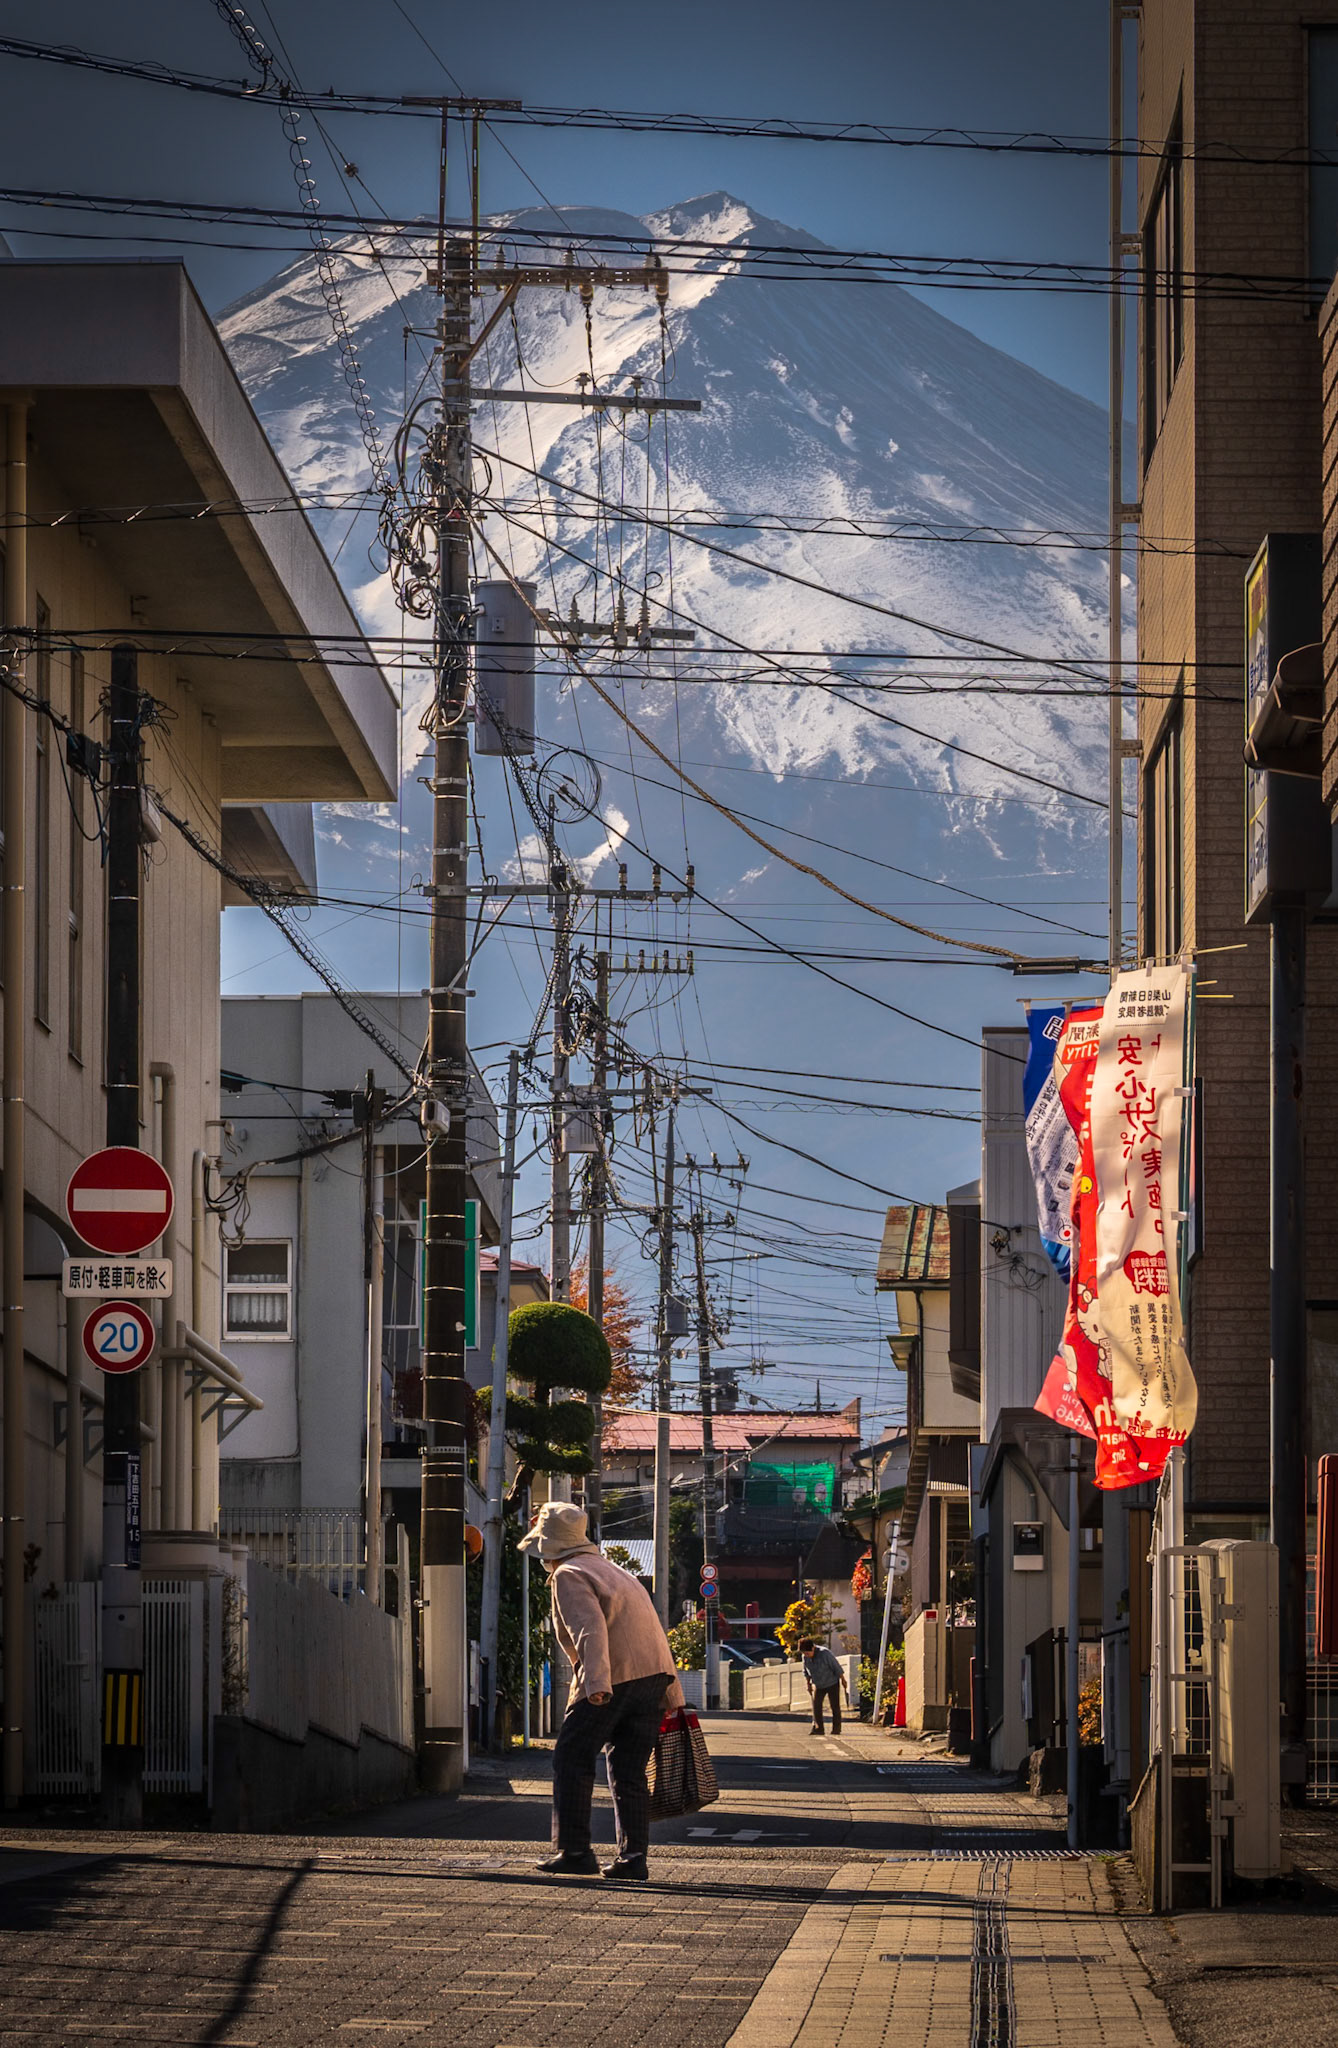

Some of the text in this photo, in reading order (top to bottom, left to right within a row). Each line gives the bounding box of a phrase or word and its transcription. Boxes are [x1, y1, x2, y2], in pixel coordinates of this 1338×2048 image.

[69, 1266, 167, 1290] 原付・軽車両を除く
[99, 1322, 138, 1353] 20
[129, 1529, 140, 1542] 15
[704, 1568, 714, 1576] 20
